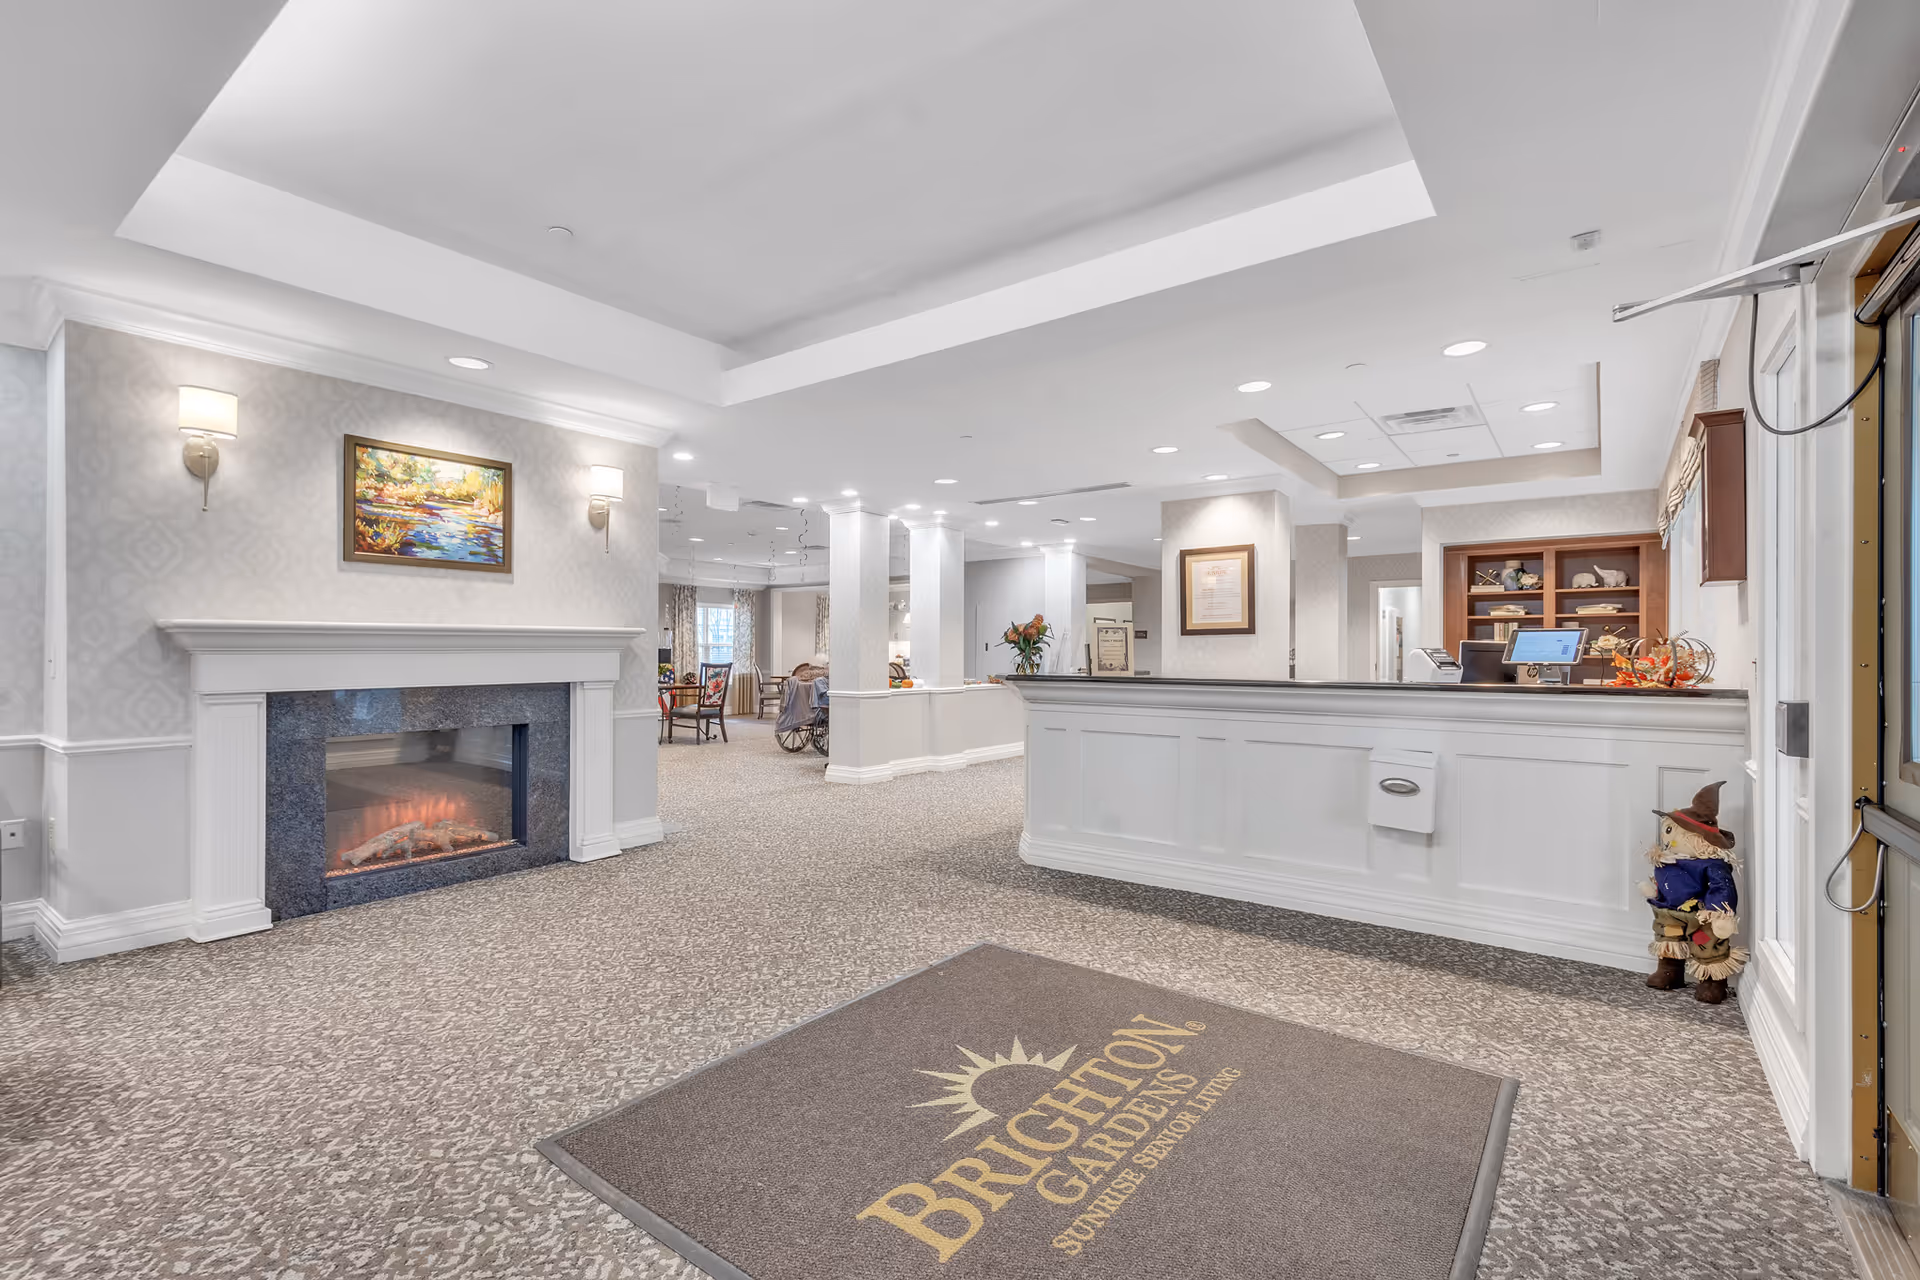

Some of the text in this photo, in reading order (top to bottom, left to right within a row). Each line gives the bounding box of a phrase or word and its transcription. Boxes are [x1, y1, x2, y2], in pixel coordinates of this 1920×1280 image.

[1036, 1068, 1198, 1204] GARDENS
[1052, 1067, 1241, 1256] SUNRISE SENIOR LIVING
